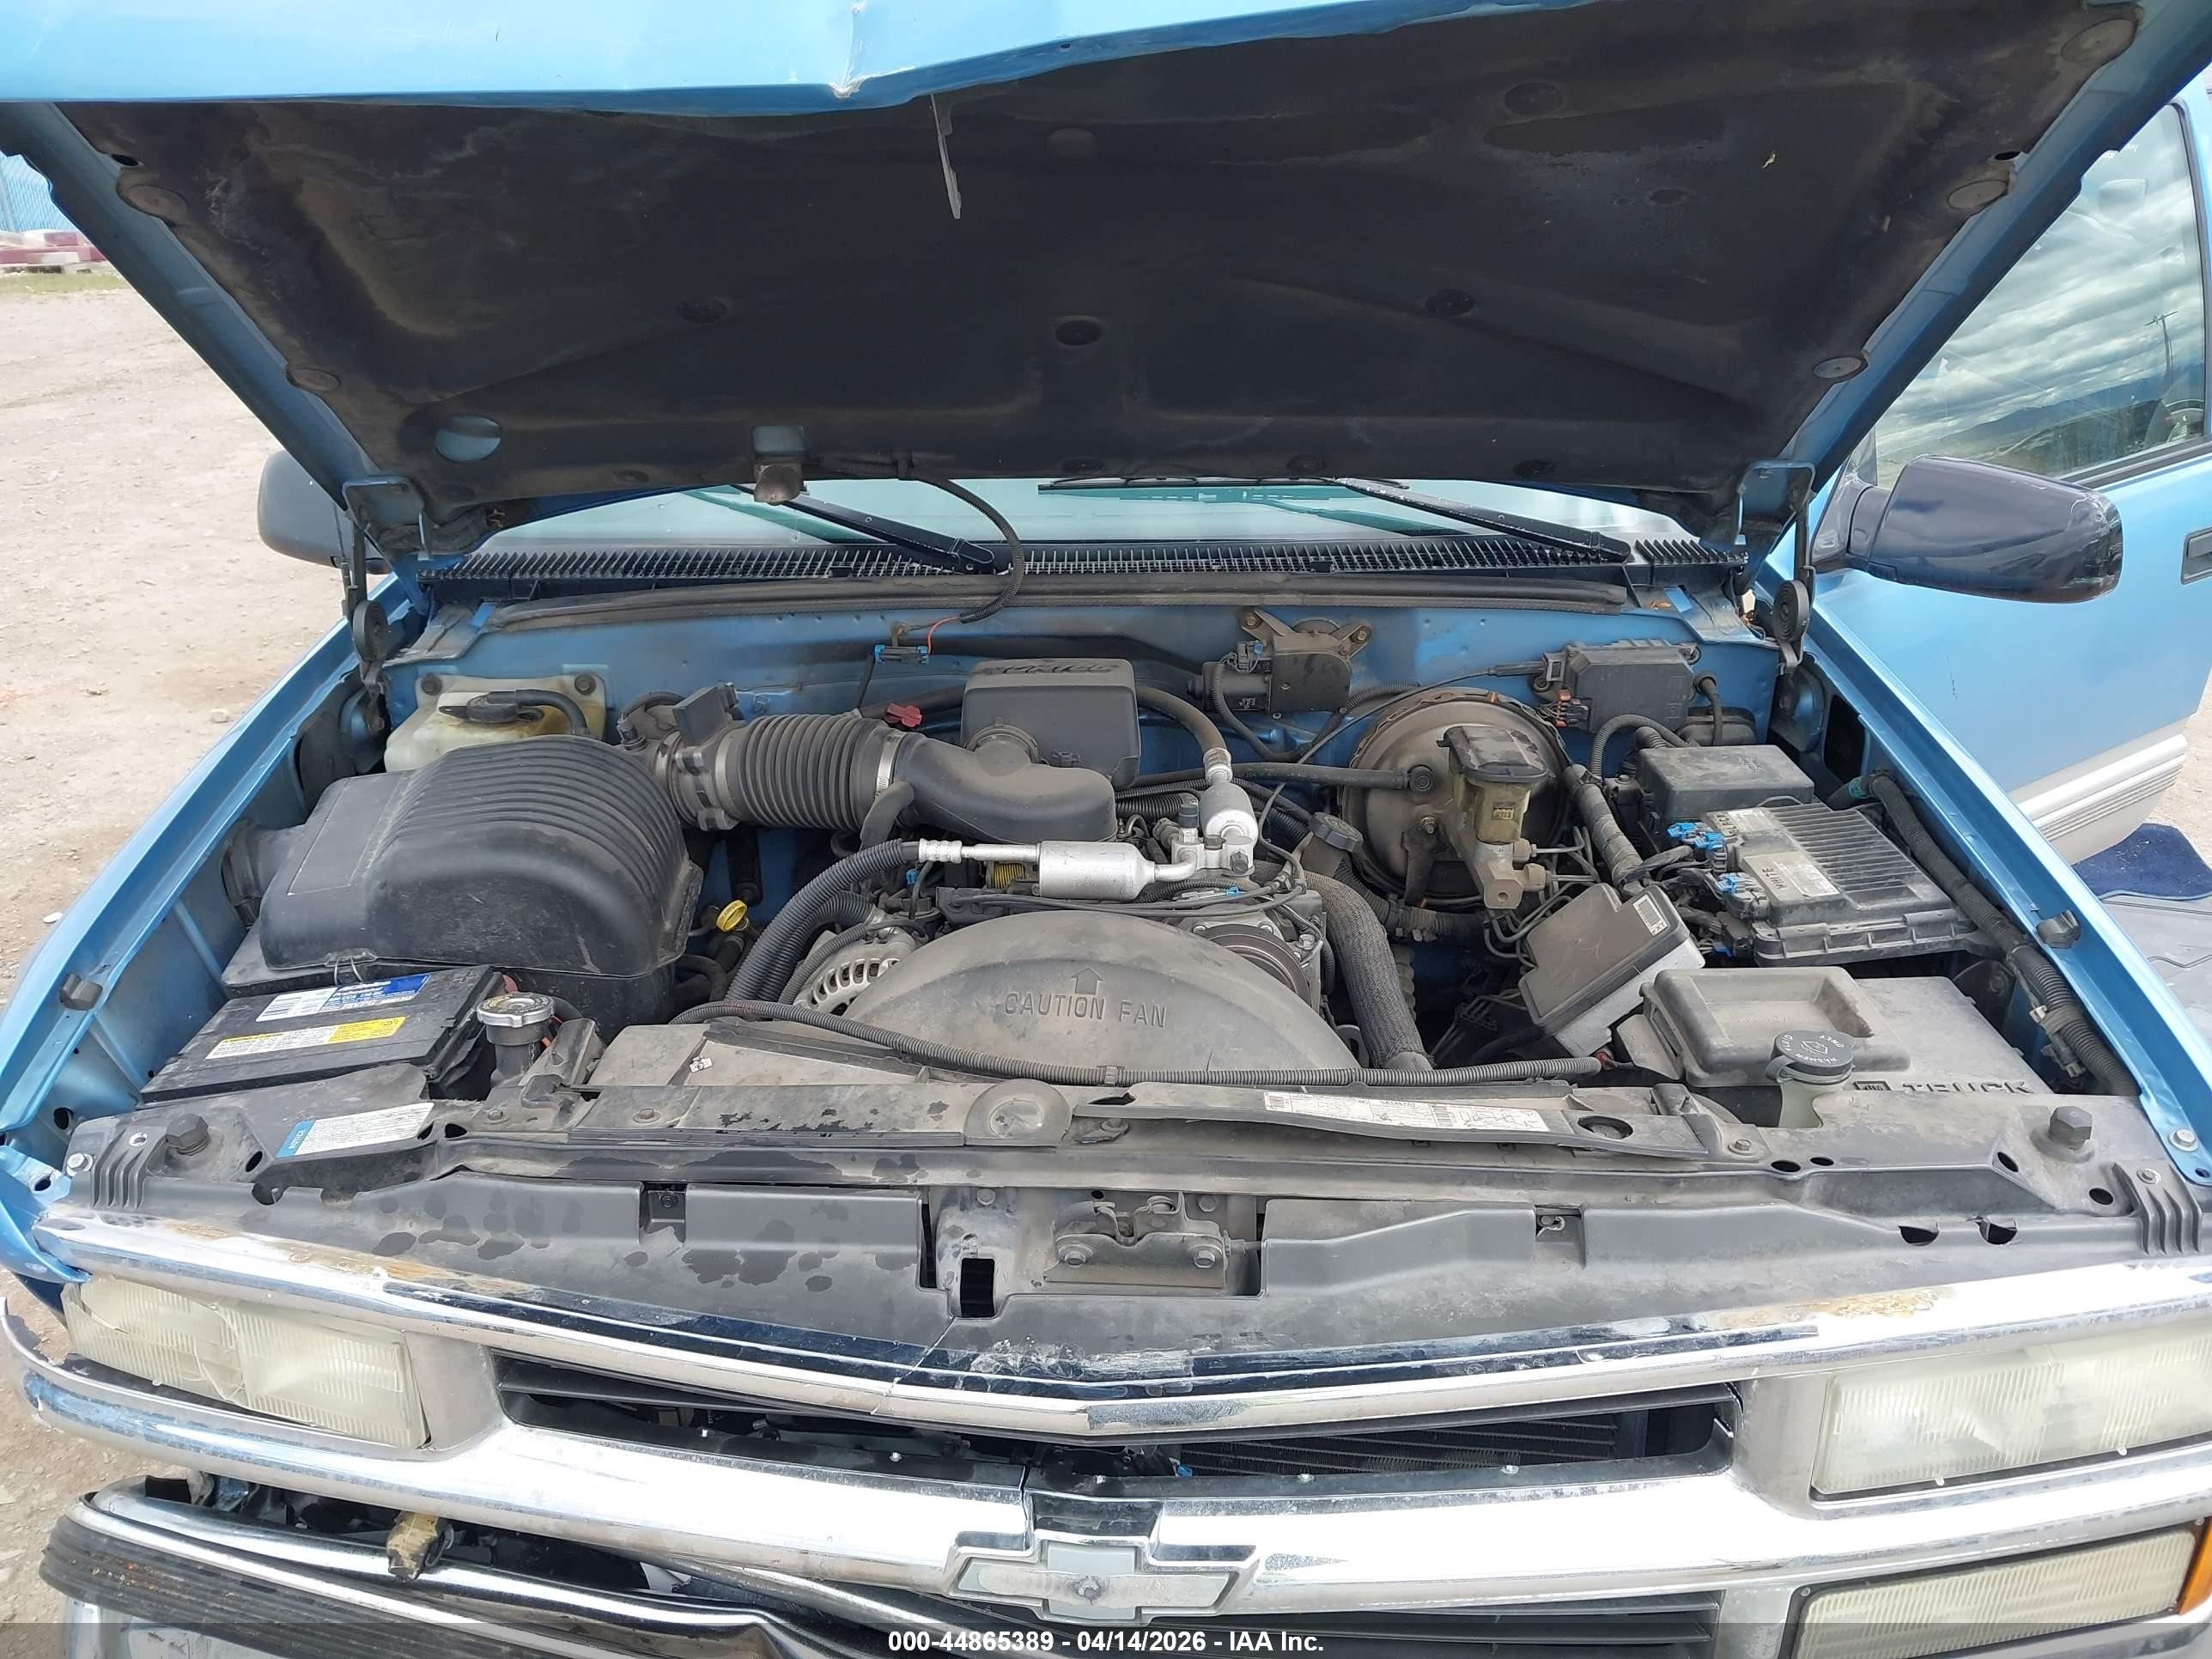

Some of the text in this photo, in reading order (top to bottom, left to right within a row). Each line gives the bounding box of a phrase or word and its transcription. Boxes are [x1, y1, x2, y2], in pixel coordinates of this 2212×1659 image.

[1761, 866, 1788, 890] WHITE
[1004, 991, 1167, 1028] CAUTION FAN
